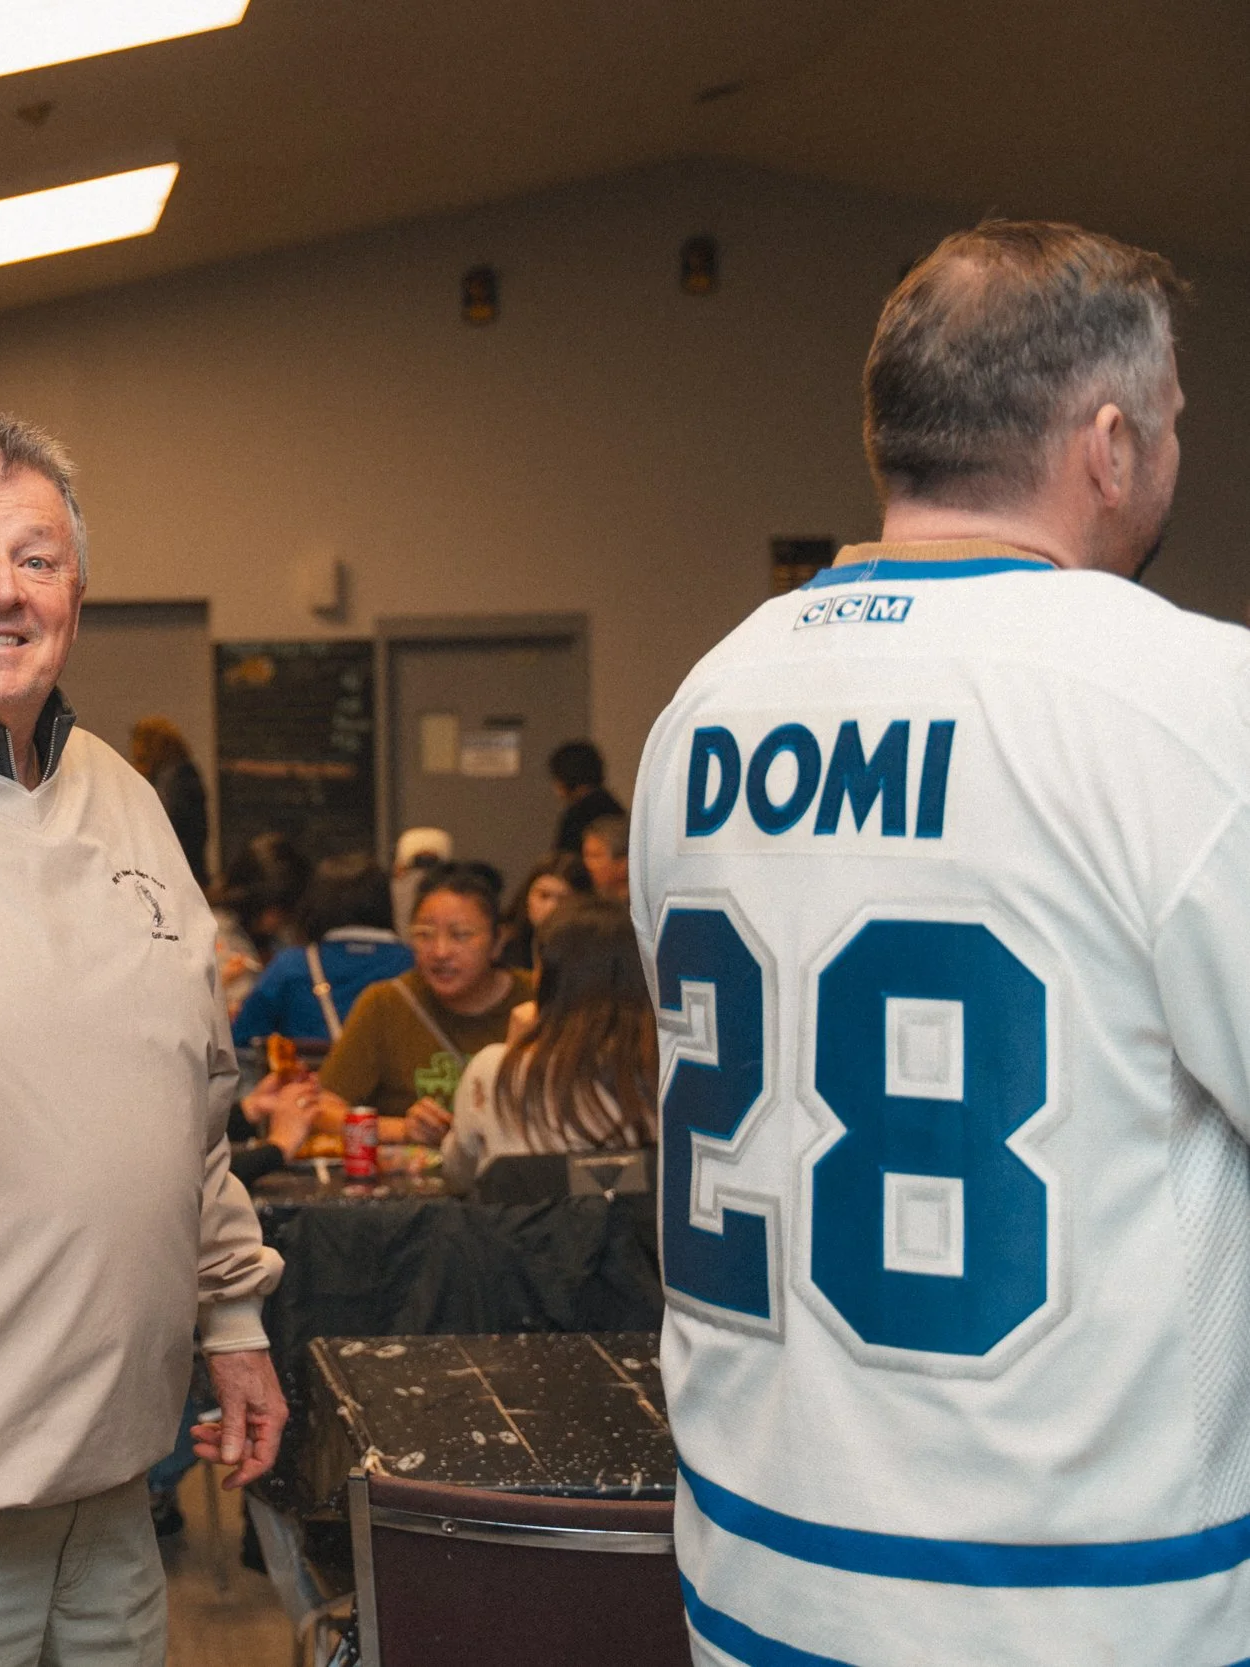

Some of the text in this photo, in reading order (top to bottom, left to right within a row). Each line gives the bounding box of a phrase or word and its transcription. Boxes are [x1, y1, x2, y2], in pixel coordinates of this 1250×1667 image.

[797, 596, 910, 626] CCM
[686, 719, 956, 839] DOMI
[653, 890, 1068, 1378] 28
